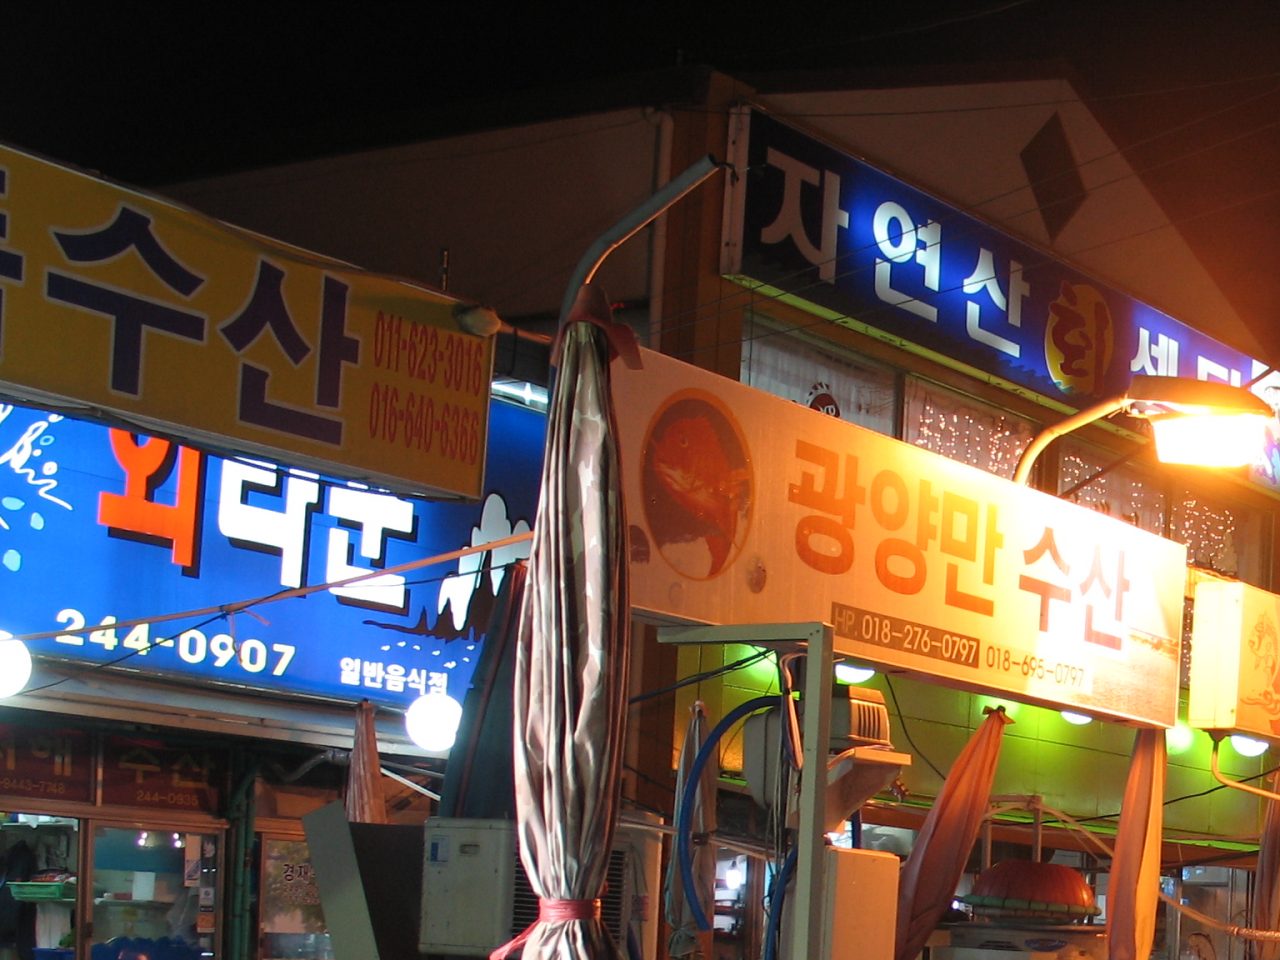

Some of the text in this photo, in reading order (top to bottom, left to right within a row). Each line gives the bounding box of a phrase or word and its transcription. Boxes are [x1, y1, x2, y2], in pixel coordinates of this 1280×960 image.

[760, 147, 1030, 358] 자연산
[0, 168, 361, 447] 수산
[374, 310, 484, 397] 011-623-3016
[788, 438, 1131, 651] 광양만 수산
[55, 608, 296, 677] 244-0907
[340, 656, 448, 697] 일반음식점
[862, 614, 978, 664] 018-276-0797
[986, 645, 1085, 688] 018-695-0797
